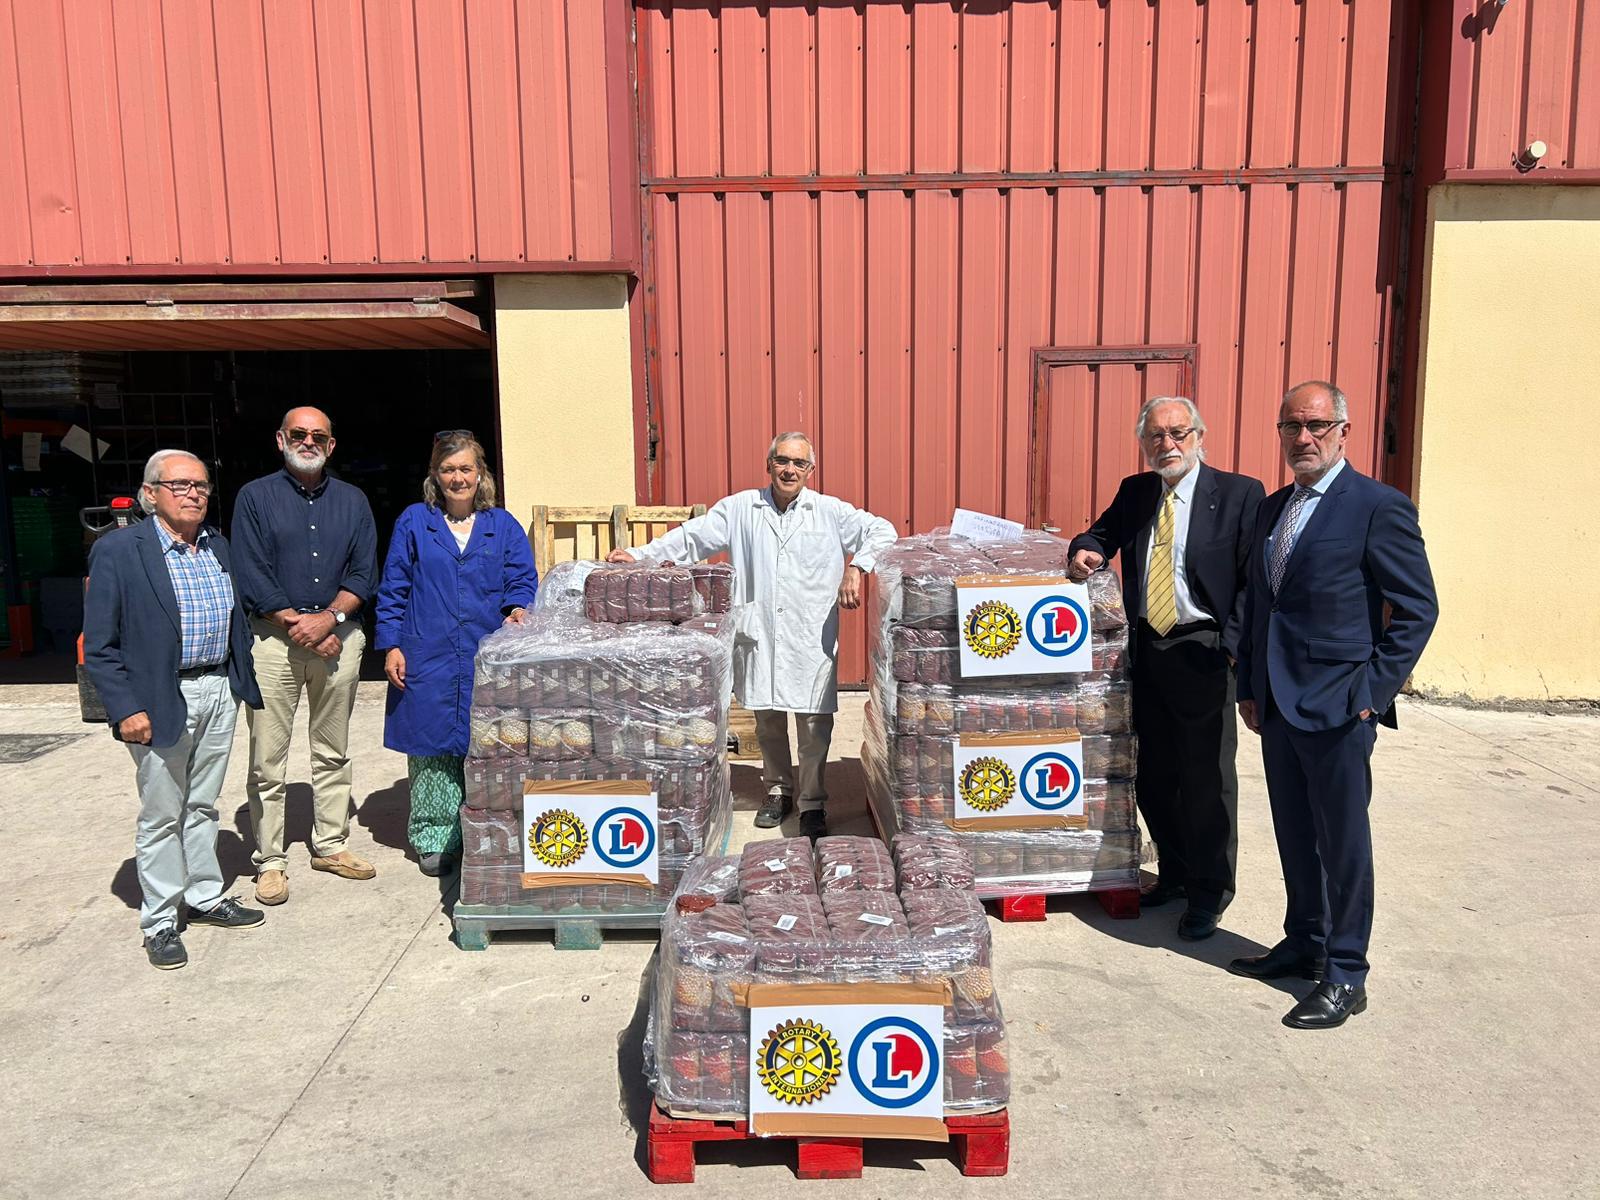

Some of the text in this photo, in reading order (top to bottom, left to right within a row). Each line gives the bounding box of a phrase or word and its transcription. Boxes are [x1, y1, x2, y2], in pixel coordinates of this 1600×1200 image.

[1042, 612, 1067, 644] L
[1035, 768, 1060, 798] L
[609, 824, 634, 854] L
[781, 1028, 817, 1039] ROTARY
[872, 1042, 908, 1088] L
[770, 1073, 829, 1094] INTERNATIONAL
